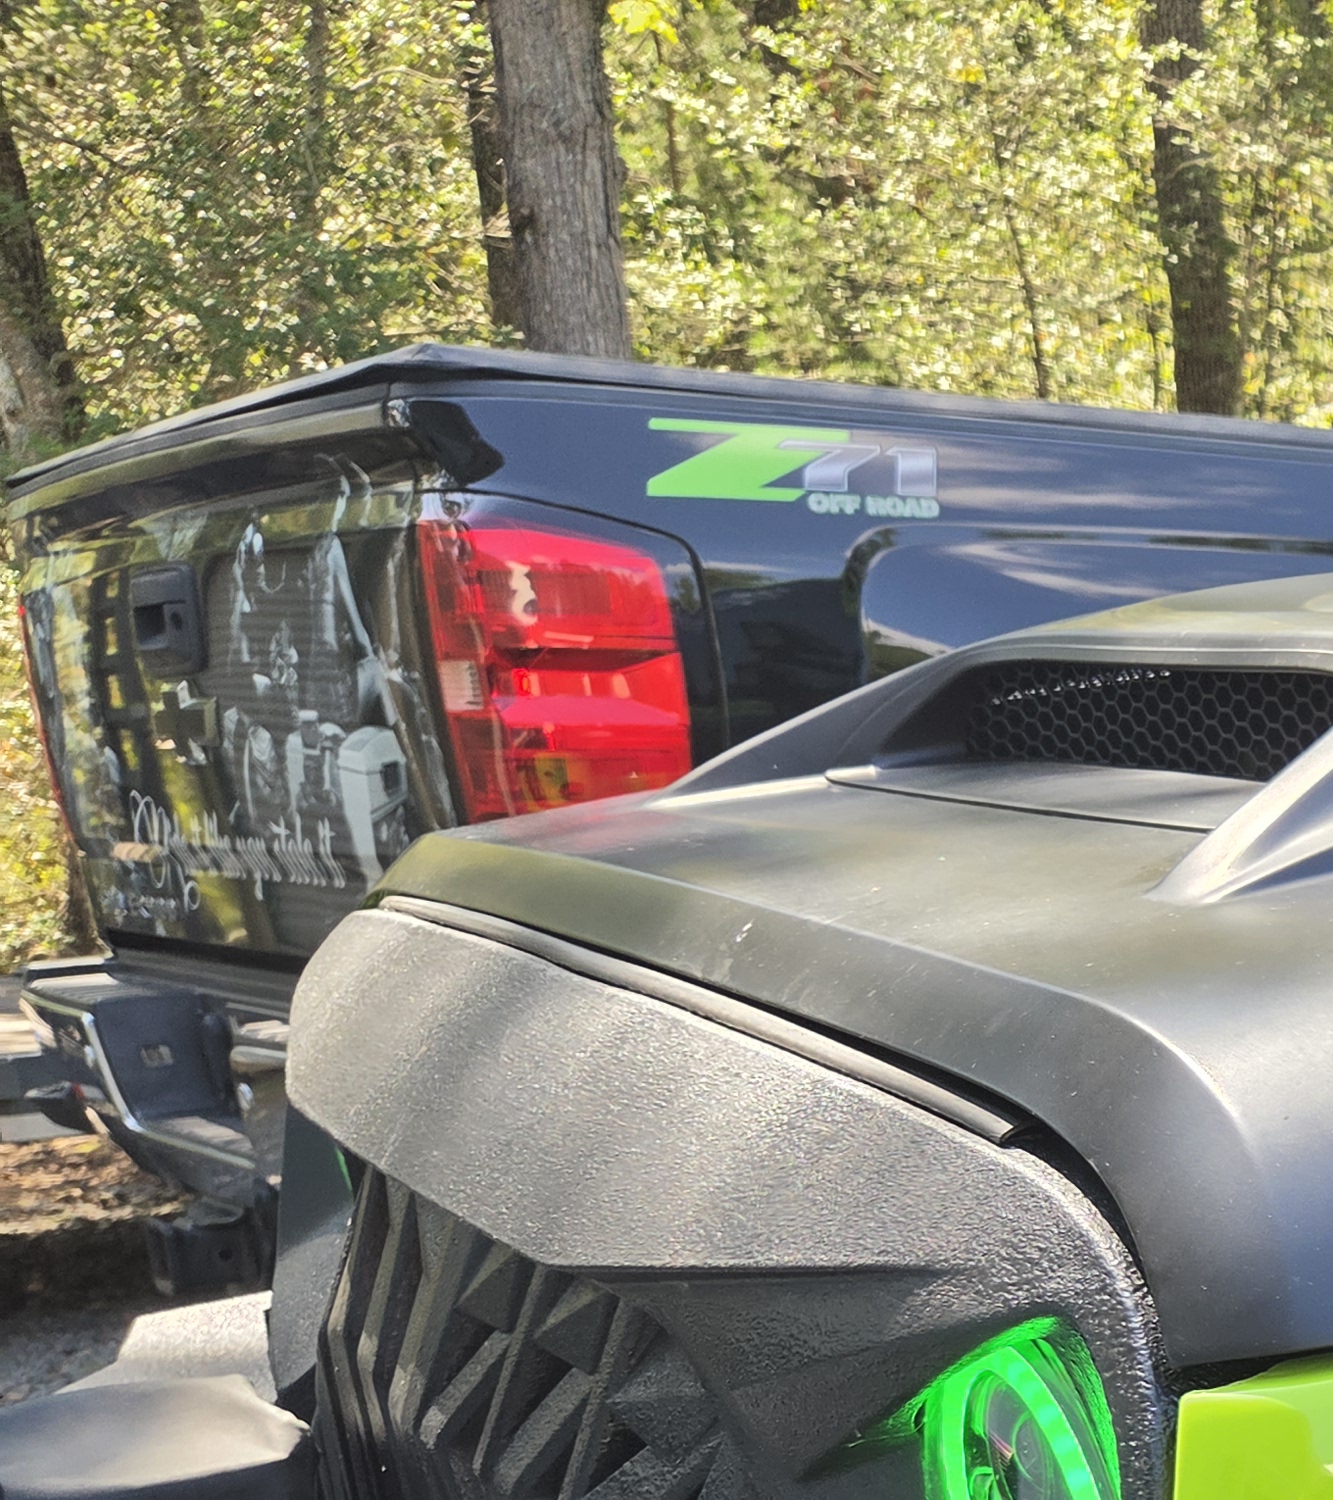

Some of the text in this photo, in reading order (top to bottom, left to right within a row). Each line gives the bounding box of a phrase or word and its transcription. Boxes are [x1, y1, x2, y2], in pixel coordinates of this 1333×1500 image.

[646, 417, 938, 502] Z71
[807, 492, 940, 519] OFF ROAD
